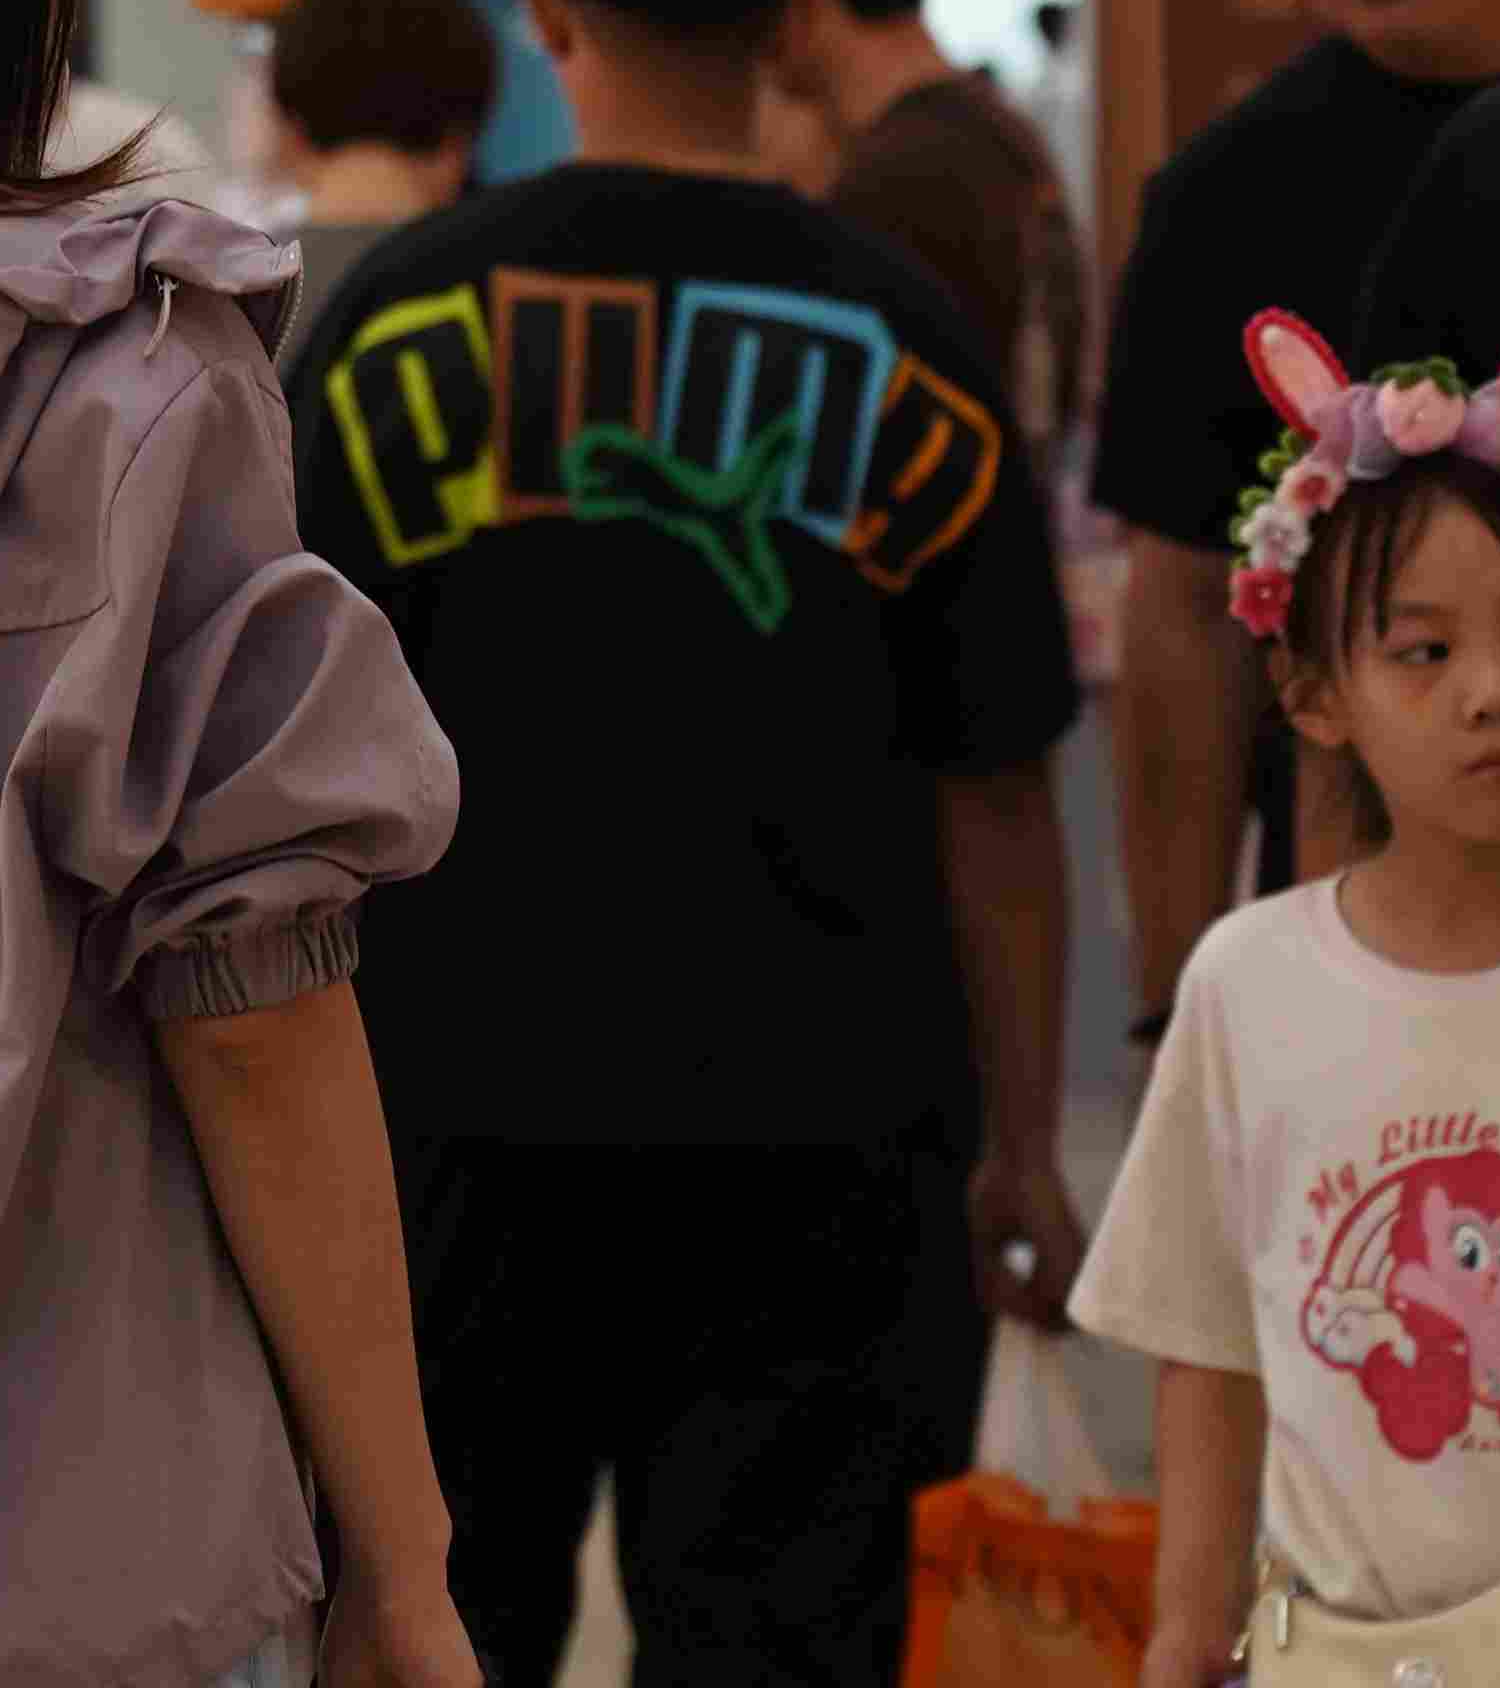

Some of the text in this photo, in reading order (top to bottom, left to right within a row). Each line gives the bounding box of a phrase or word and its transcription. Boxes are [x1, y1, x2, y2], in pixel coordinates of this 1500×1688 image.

[326, 268, 1002, 594] PUMA
[1306, 1162, 1360, 1223] My
[1379, 1109, 1500, 1165] Little
